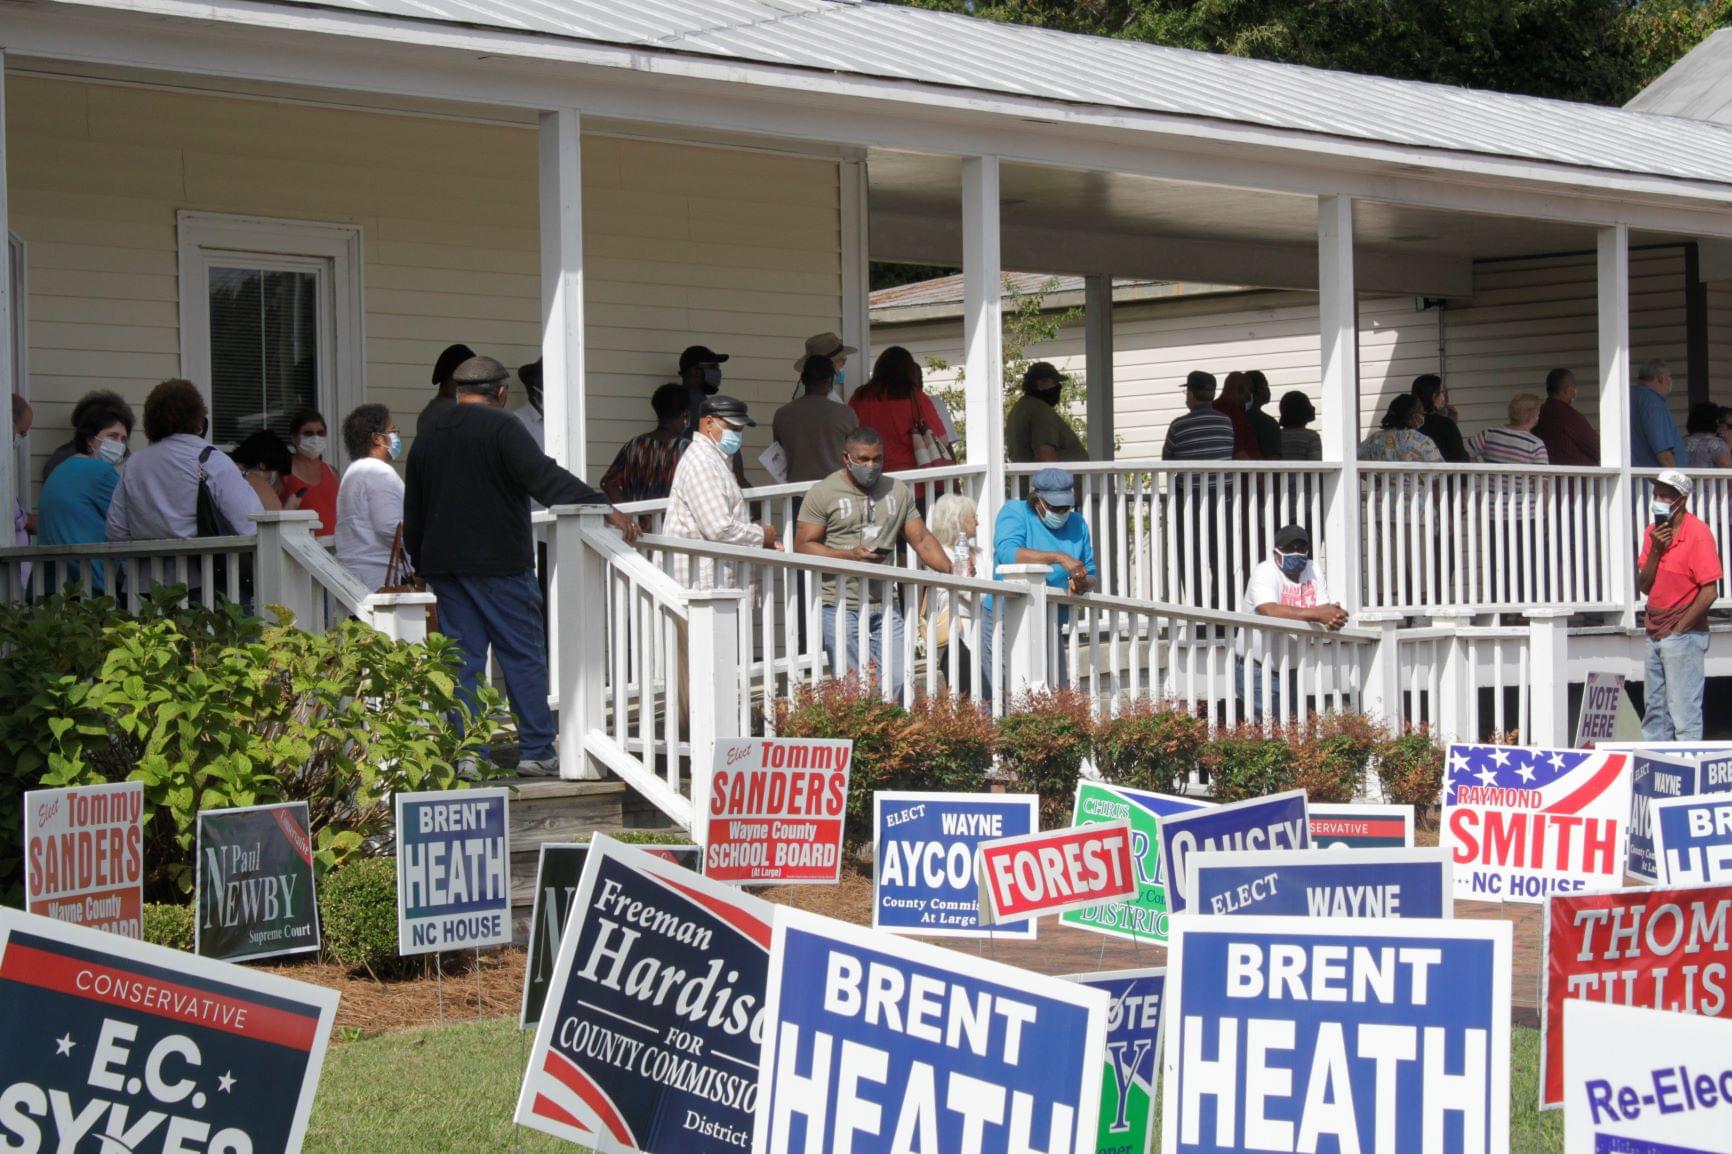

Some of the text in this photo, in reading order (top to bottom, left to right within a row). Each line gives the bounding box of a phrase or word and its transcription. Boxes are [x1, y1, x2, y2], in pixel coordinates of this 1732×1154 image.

[1588, 686, 1620, 711] VOTE
[1581, 714, 1616, 738] HERE
[726, 741, 849, 772] Elect Tommy
[710, 770, 846, 816] SANDERS
[1634, 762, 1681, 796] ELECT WAYNE
[38, 791, 141, 828] Elect Tommy
[1083, 797, 1131, 819] CHRIS
[1457, 785, 1543, 809] RAYMOND
[281, 809, 310, 856] Conservative
[419, 802, 490, 834] BRENT
[729, 820, 817, 842] Wayne County
[886, 804, 1003, 837] ELECT WAYNE
[232, 842, 260, 874] Paul
[708, 843, 836, 869] SCHOOL BOARD
[1449, 808, 1617, 875] SMITH
[30, 824, 141, 896] SANDERS
[405, 836, 505, 909] HEATH
[992, 836, 1123, 907] FOREST
[203, 845, 298, 929] NEWBY
[1211, 873, 1278, 915] ELECT
[1307, 885, 1400, 918] WAYNE
[1472, 872, 1501, 894] NC
[48, 894, 122, 922] Wayne County
[594, 878, 713, 950] Freeman
[882, 896, 926, 912] County
[921, 912, 977, 926] At Large
[249, 923, 311, 945] Supreme Court
[413, 915, 501, 947] NC HOUSE
[1573, 899, 1732, 962] THOM
[1226, 943, 1442, 1005] BRENT
[75, 970, 248, 1029] CONSERVATIVE
[824, 950, 1037, 1066] BRENT
[560, 1016, 644, 1071] COUNTY
[665, 1027, 704, 1056] FOR
[86, 1017, 207, 1110] E.C.
[1181, 1015, 1488, 1154] HEATH
[683, 1110, 748, 1148] District
